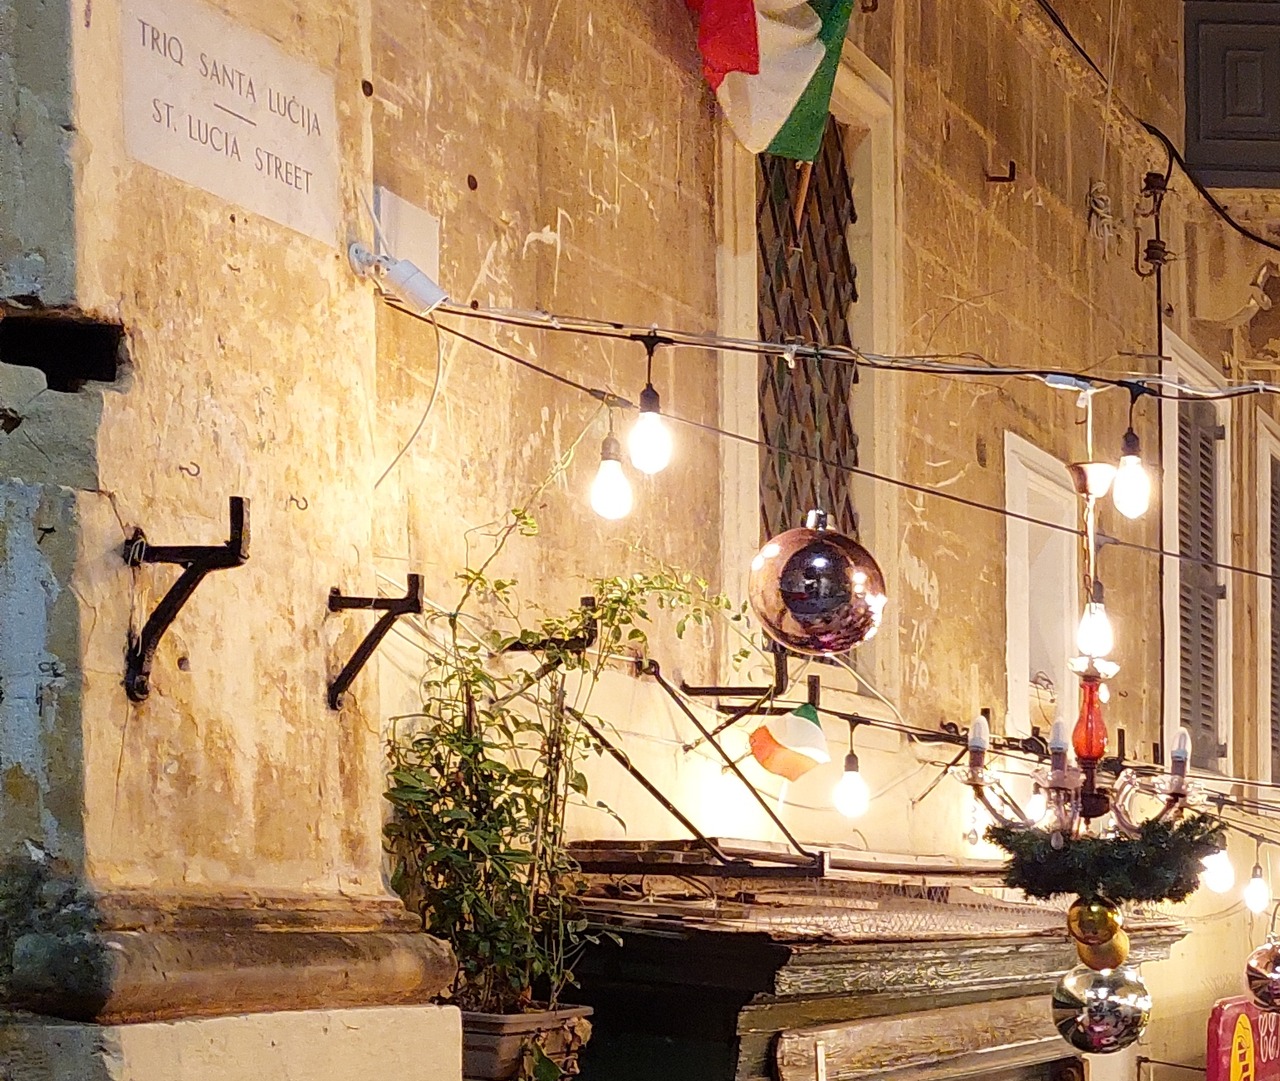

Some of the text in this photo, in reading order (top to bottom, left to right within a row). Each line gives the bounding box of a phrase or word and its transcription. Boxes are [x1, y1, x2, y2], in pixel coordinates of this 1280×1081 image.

[137, 18, 321, 137] TRIQ SANTA LUĊIJA
[152, 98, 313, 194] ST. LUCIA STREET
